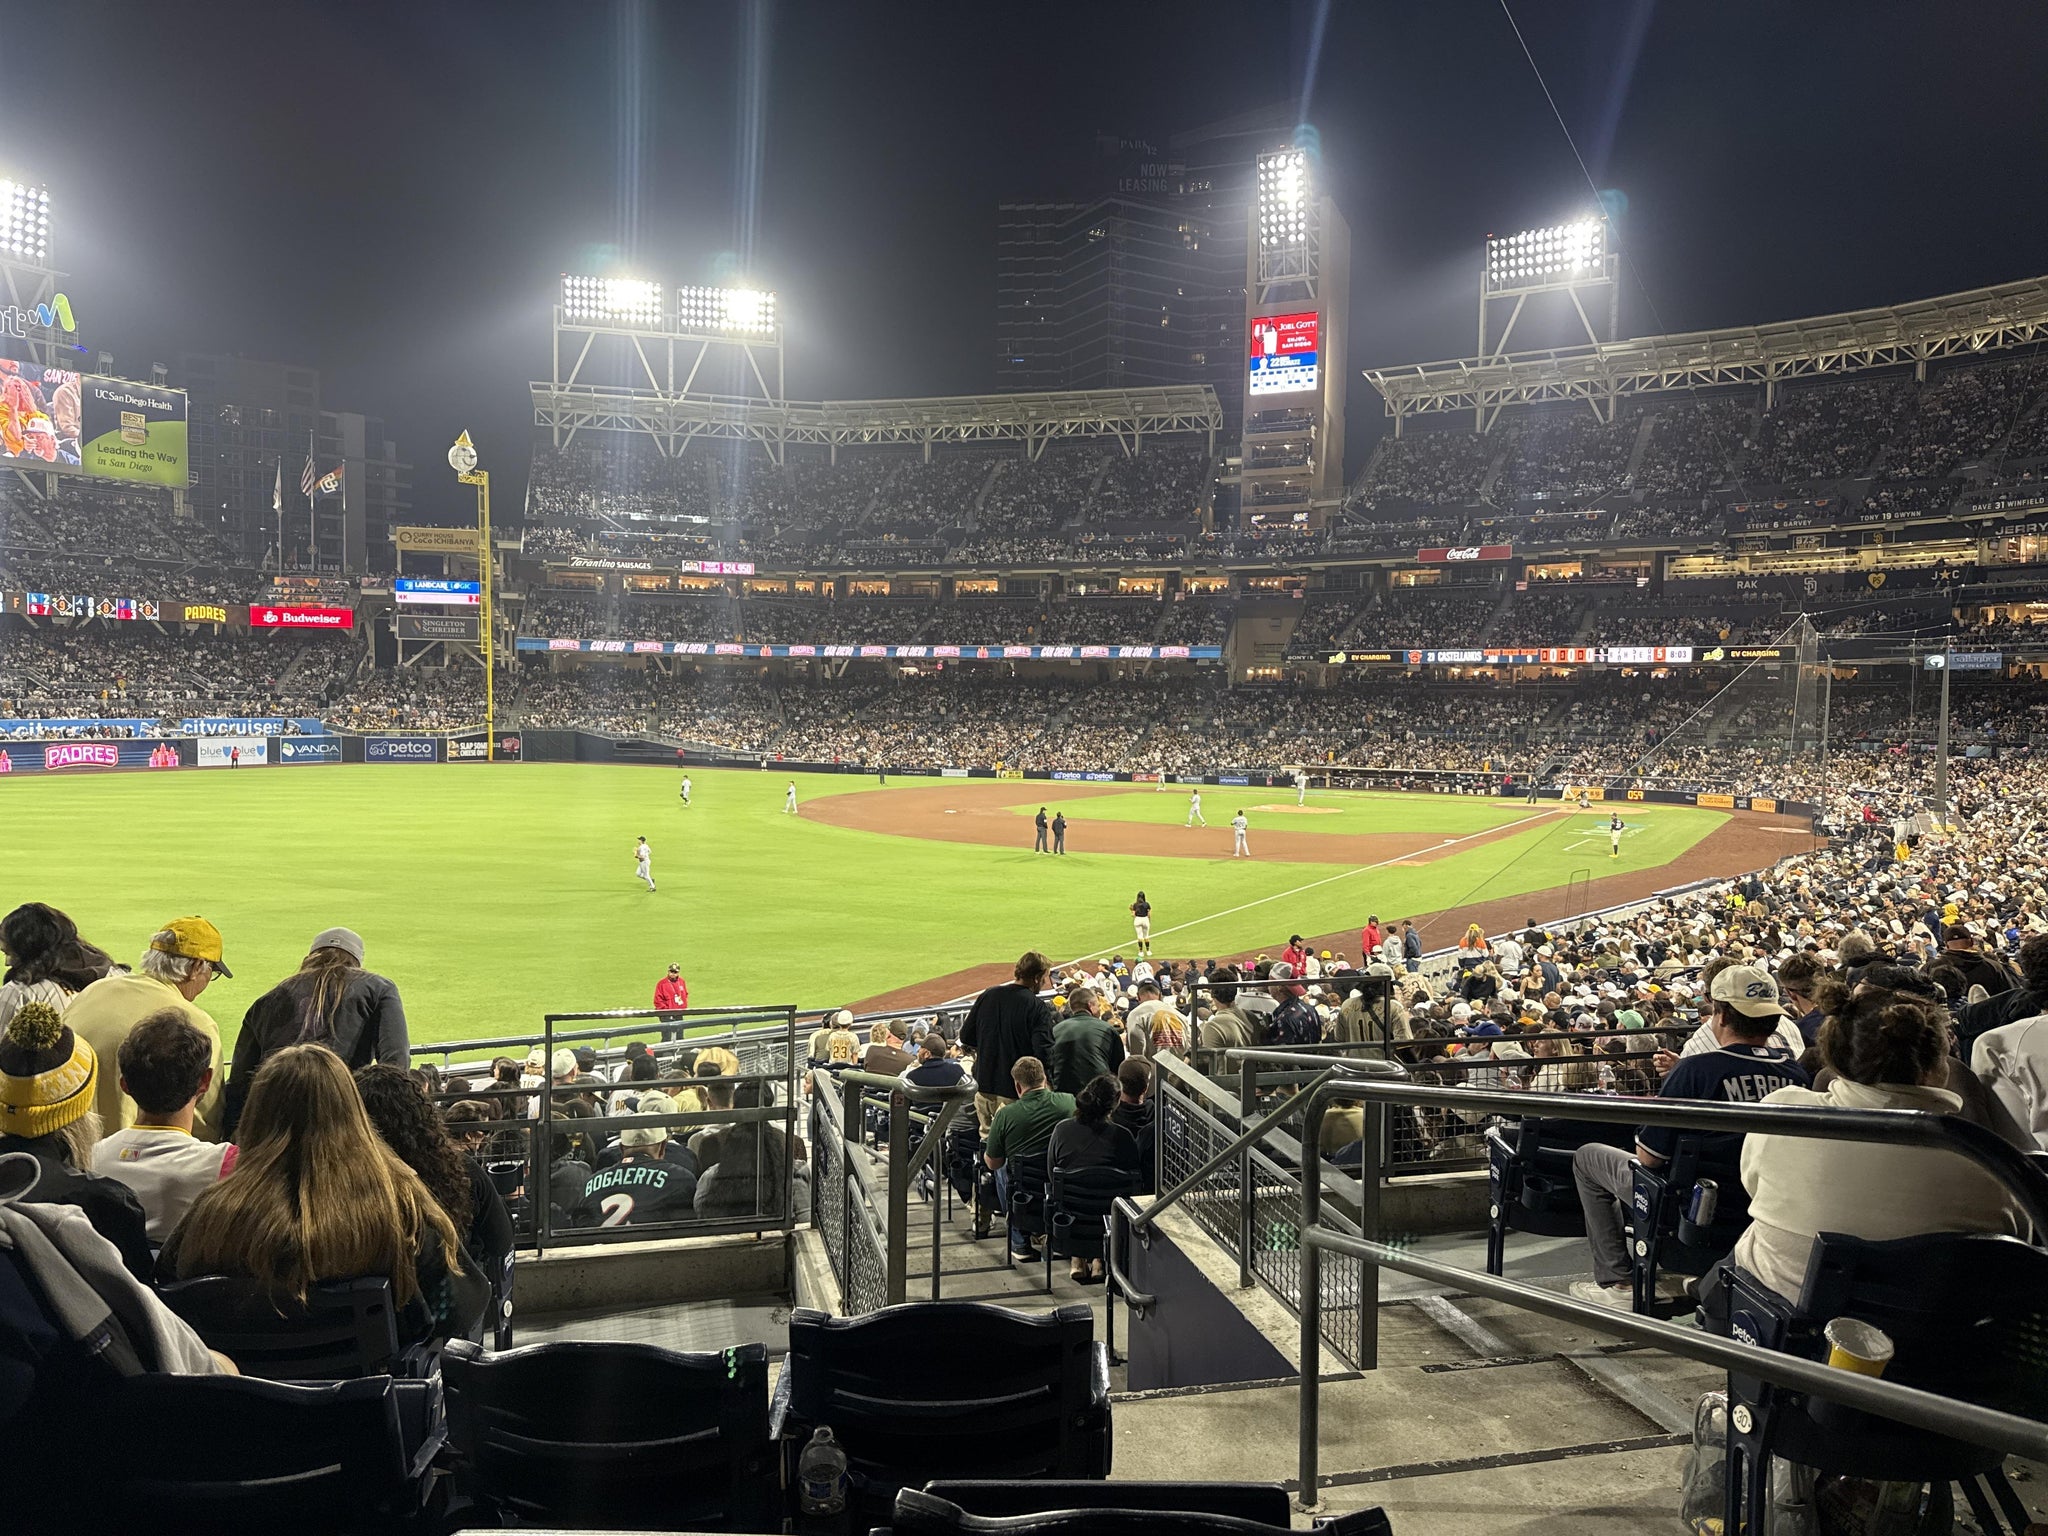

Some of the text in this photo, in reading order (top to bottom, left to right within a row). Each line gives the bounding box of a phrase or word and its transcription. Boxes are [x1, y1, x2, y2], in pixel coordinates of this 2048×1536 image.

[1141, 164, 1167, 177] NOW
[1119, 179, 1168, 192] LEASING
[1279, 320, 1316, 331] JOEL GOTT
[95, 388, 172, 411] UC San Diego Health
[122, 413, 144, 422] BEST
[97, 444, 178, 464] Leading the Way
[98, 456, 152, 472] in San Diego
[1972, 498, 2045, 512] DAVE 31 WINFIELD
[1860, 510, 1922, 522] TONY 19 GWYNN
[1746, 522, 1770, 530] STEVE
[1995, 522, 2048, 536] JERRY
[434, 538, 474, 546] ICHIBANYA
[570, 556, 651, 570] Tarantino SAUSAGES
[1931, 570, 1960, 580] J C
[1736, 580, 1758, 590] RAK
[13, 597, 20, 608] F
[43, 594, 50, 604] 2
[59, 600, 66, 610] 9
[43, 604, 50, 615] 7
[184, 605, 226, 622] PADRES
[282, 612, 341, 624] Budweiser
[422, 619, 466, 627] SINGLETON
[422, 626, 466, 634] SCHREIBER
[550, 640, 580, 650] PADRES
[590, 640, 626, 652] SAN DIEGO
[634, 642, 664, 652] PADRES
[1438, 651, 1482, 662] CASTELLANOS
[182, 720, 282, 736] citycruises
[200, 746, 222, 755] blue
[294, 745, 339, 753] VANDA
[389, 741, 432, 755] petco
[48, 746, 116, 766] PADRES
[1114, 967, 1128, 976] 22
[1137, 966, 1147, 975] 21
[1358, 1020, 1374, 1042] 11
[833, 1046, 847, 1058] 23
[1168, 1117, 1181, 1139] 122
[585, 1167, 668, 1198] BOGAERTS
[1635, 1192, 1648, 1206] petco
[600, 1193, 635, 1228] 2
[1636, 1200, 1648, 1213] park
[1733, 1322, 1756, 1347] petco
[1737, 1410, 1748, 1428] 30
